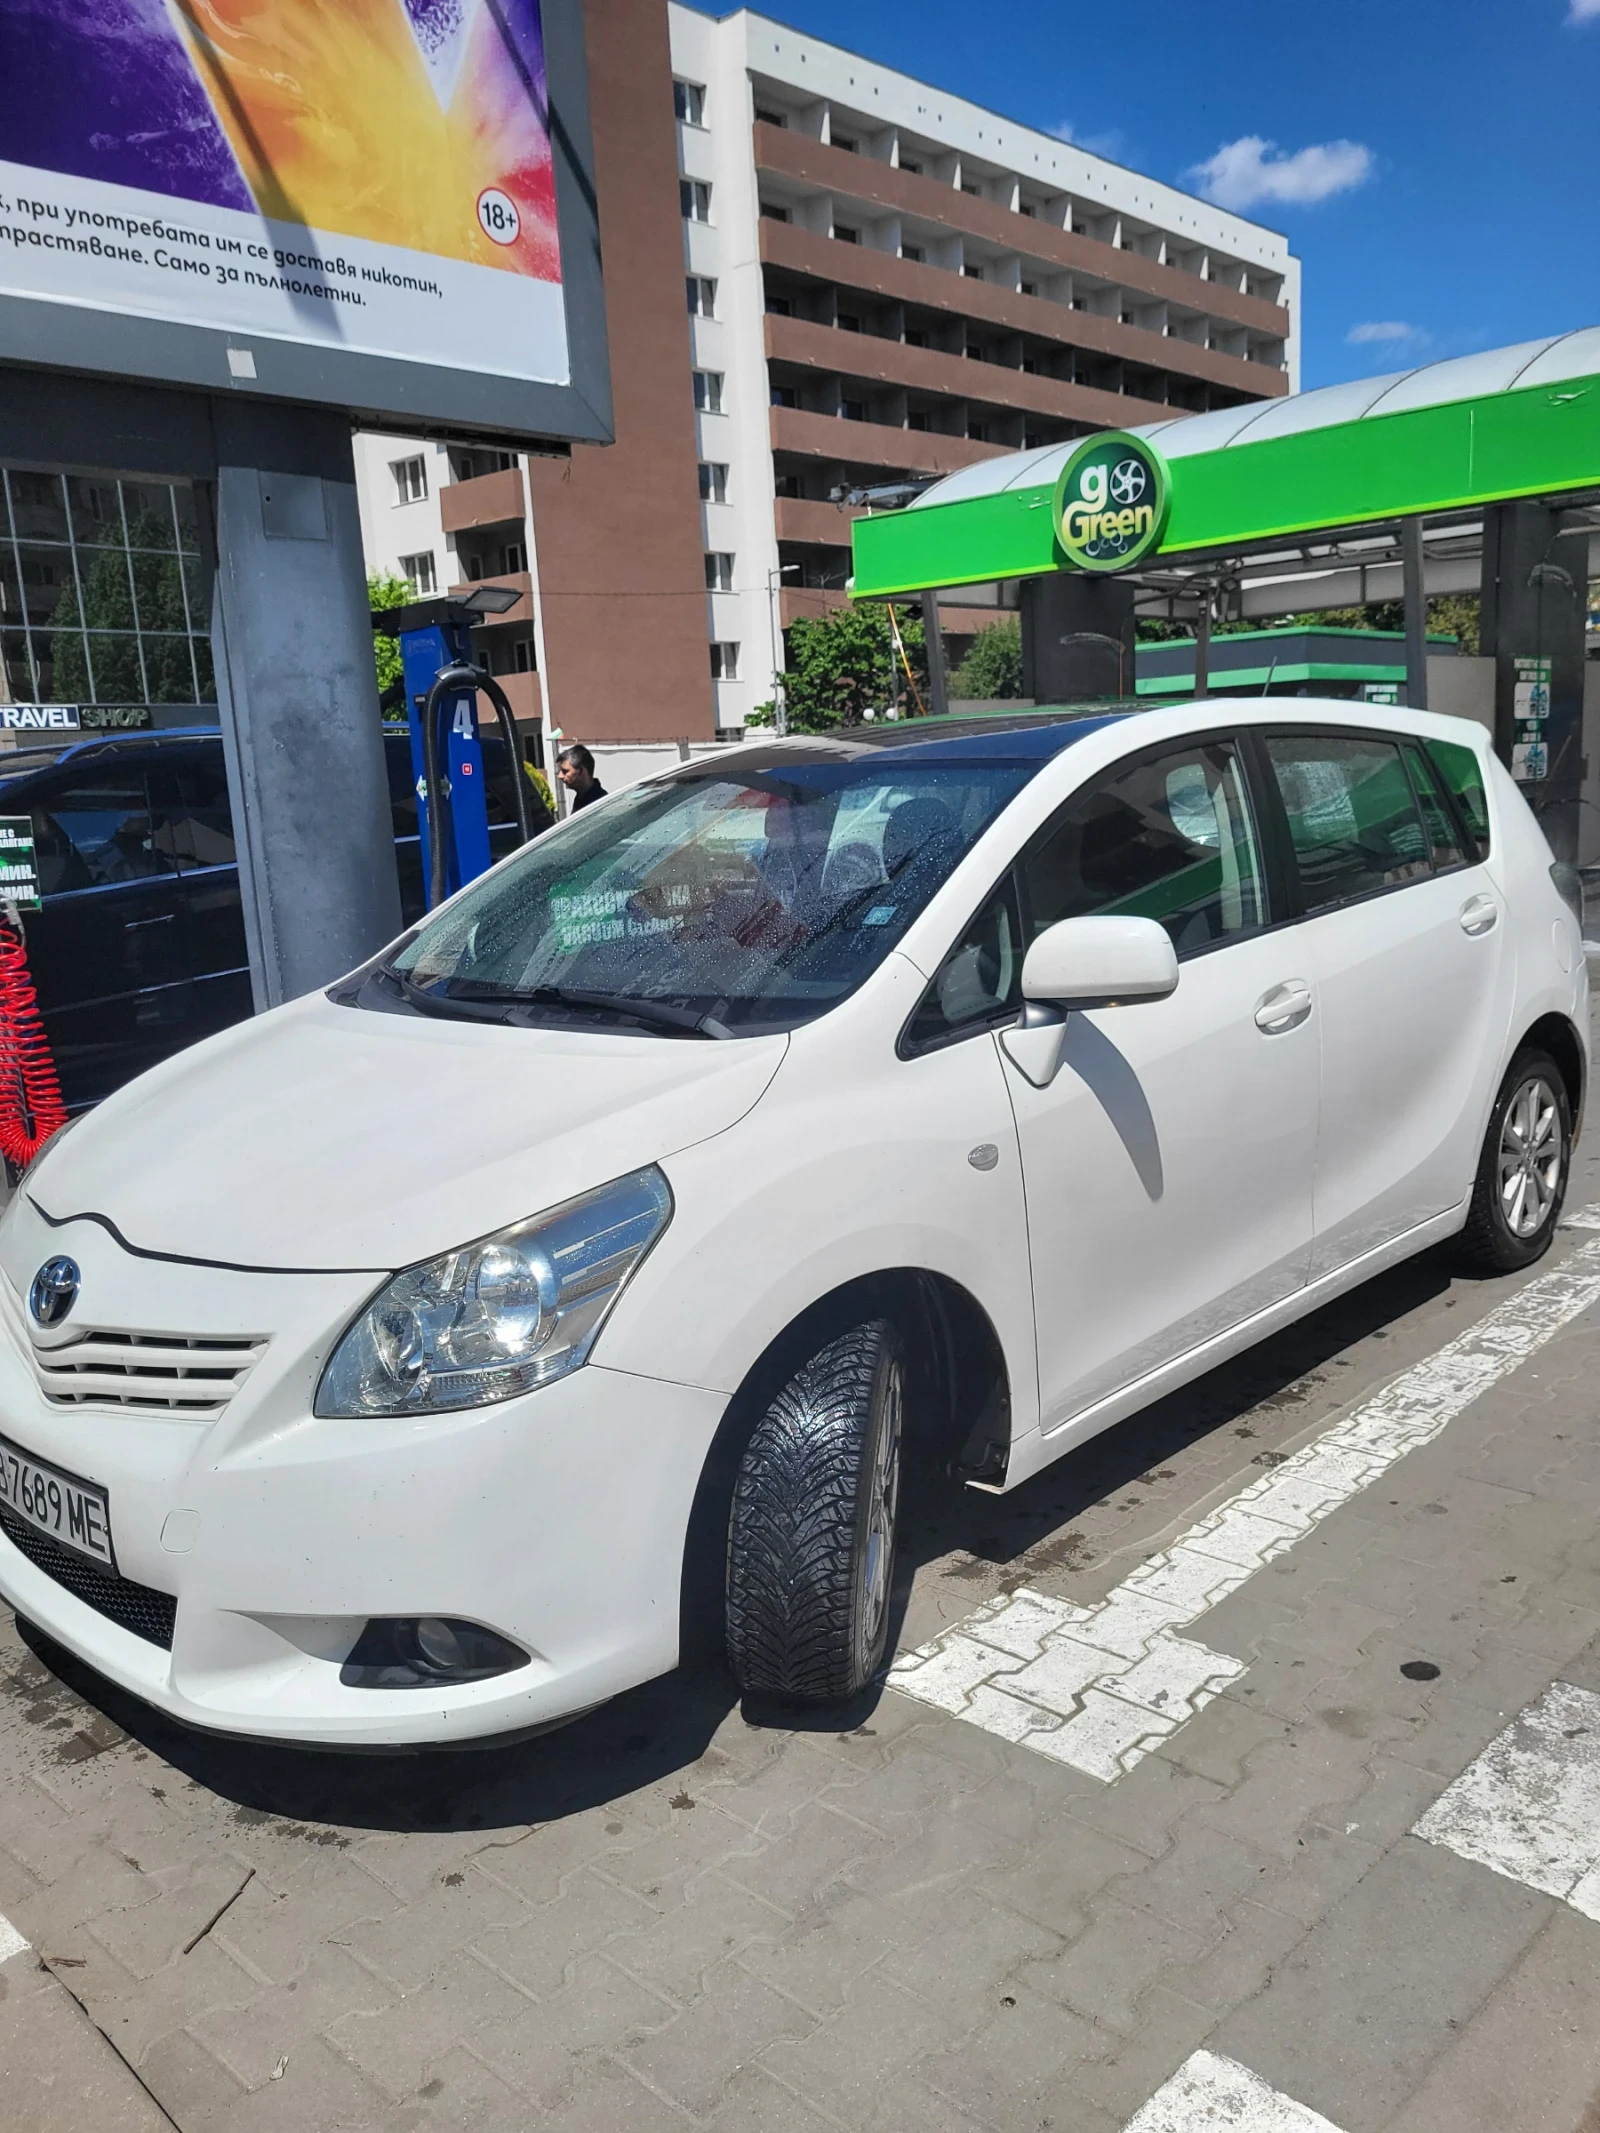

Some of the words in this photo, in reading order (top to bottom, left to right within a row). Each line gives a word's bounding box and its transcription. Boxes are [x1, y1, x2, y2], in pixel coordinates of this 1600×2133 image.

[482, 202, 516, 230] 18+
[17, 197, 59, 221] при
[64, 207, 210, 248] употребата
[216, 236, 242, 255] им
[247, 244, 268, 260] се
[273, 249, 356, 279] доставя
[361, 266, 443, 298] никотин,
[154, 249, 211, 276] Само
[215, 265, 239, 285] за
[244, 269, 367, 306] пълнолетни.
[1062, 501, 1153, 549] Green
[82, 708, 148, 727] SHOP
[453, 699, 474, 740] 4
